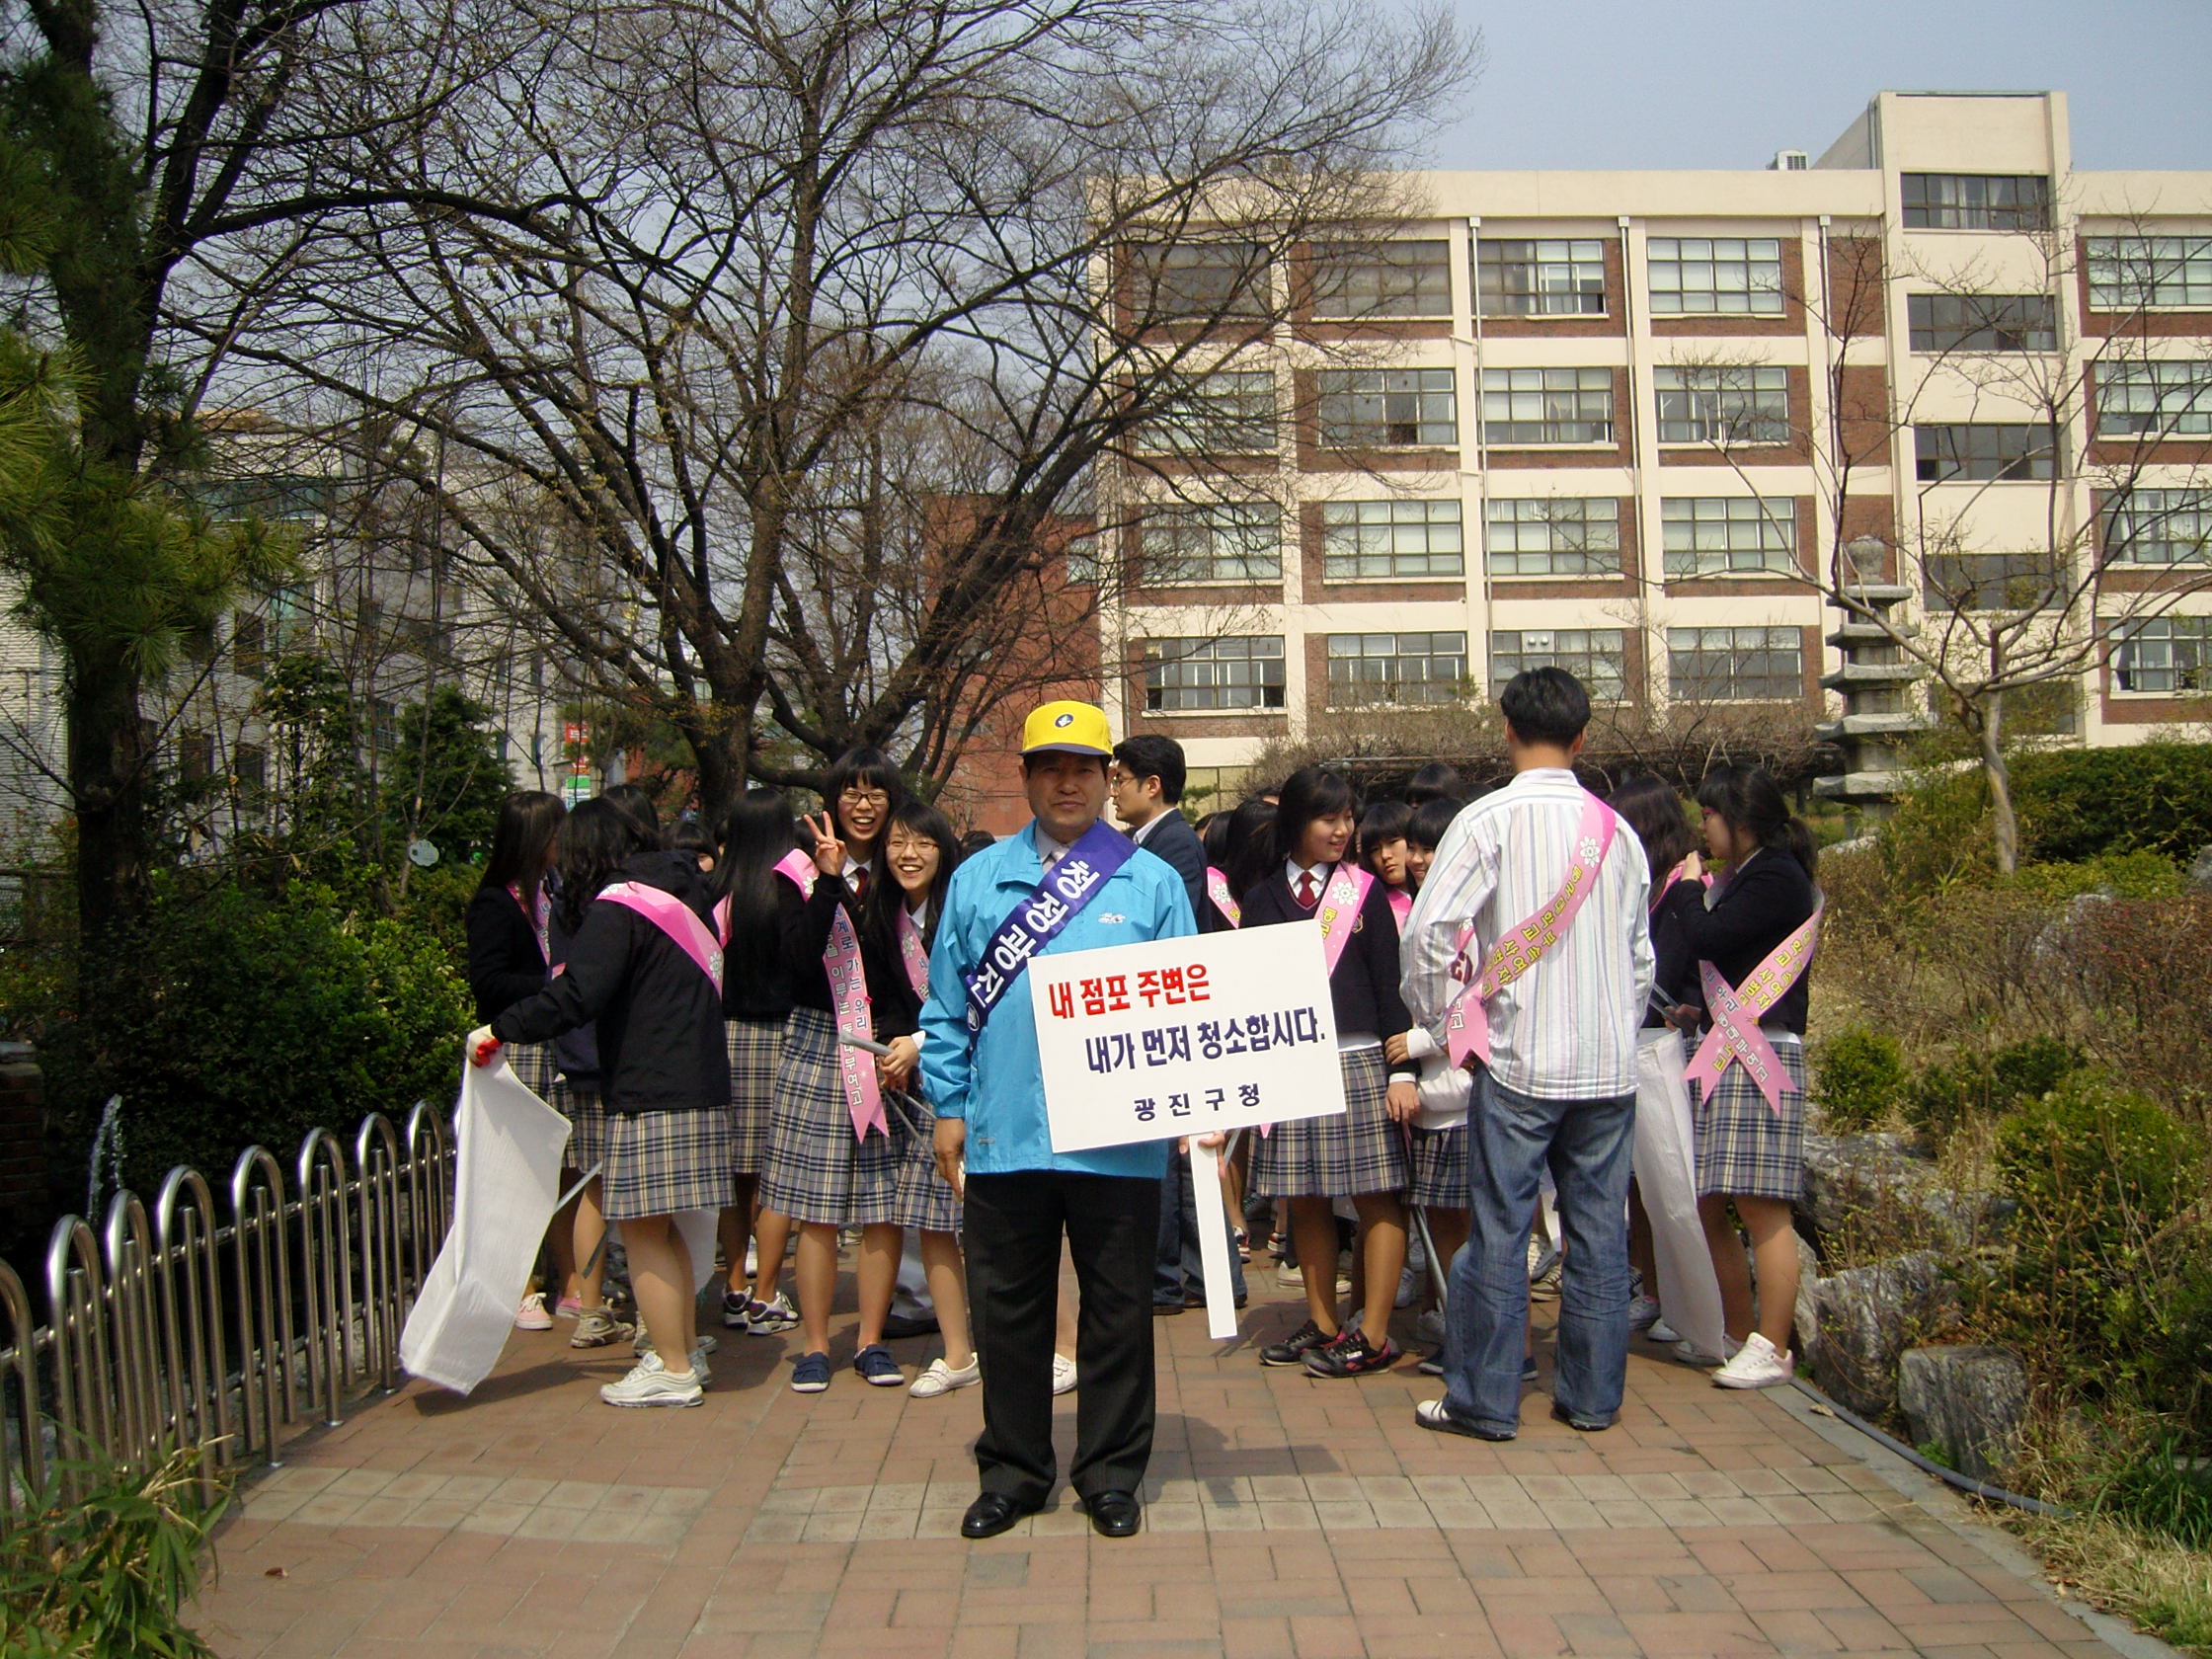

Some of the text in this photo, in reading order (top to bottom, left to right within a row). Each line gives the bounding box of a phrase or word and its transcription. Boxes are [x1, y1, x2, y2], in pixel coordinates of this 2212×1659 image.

[830, 965, 850, 1015] 이루는
[846, 958, 861, 990] 가는
[854, 998, 867, 1029] 우리
[1048, 964, 1211, 1020] 내 점포 주변은
[1085, 1006, 1326, 1074] 내가 먼저 청소합시다.
